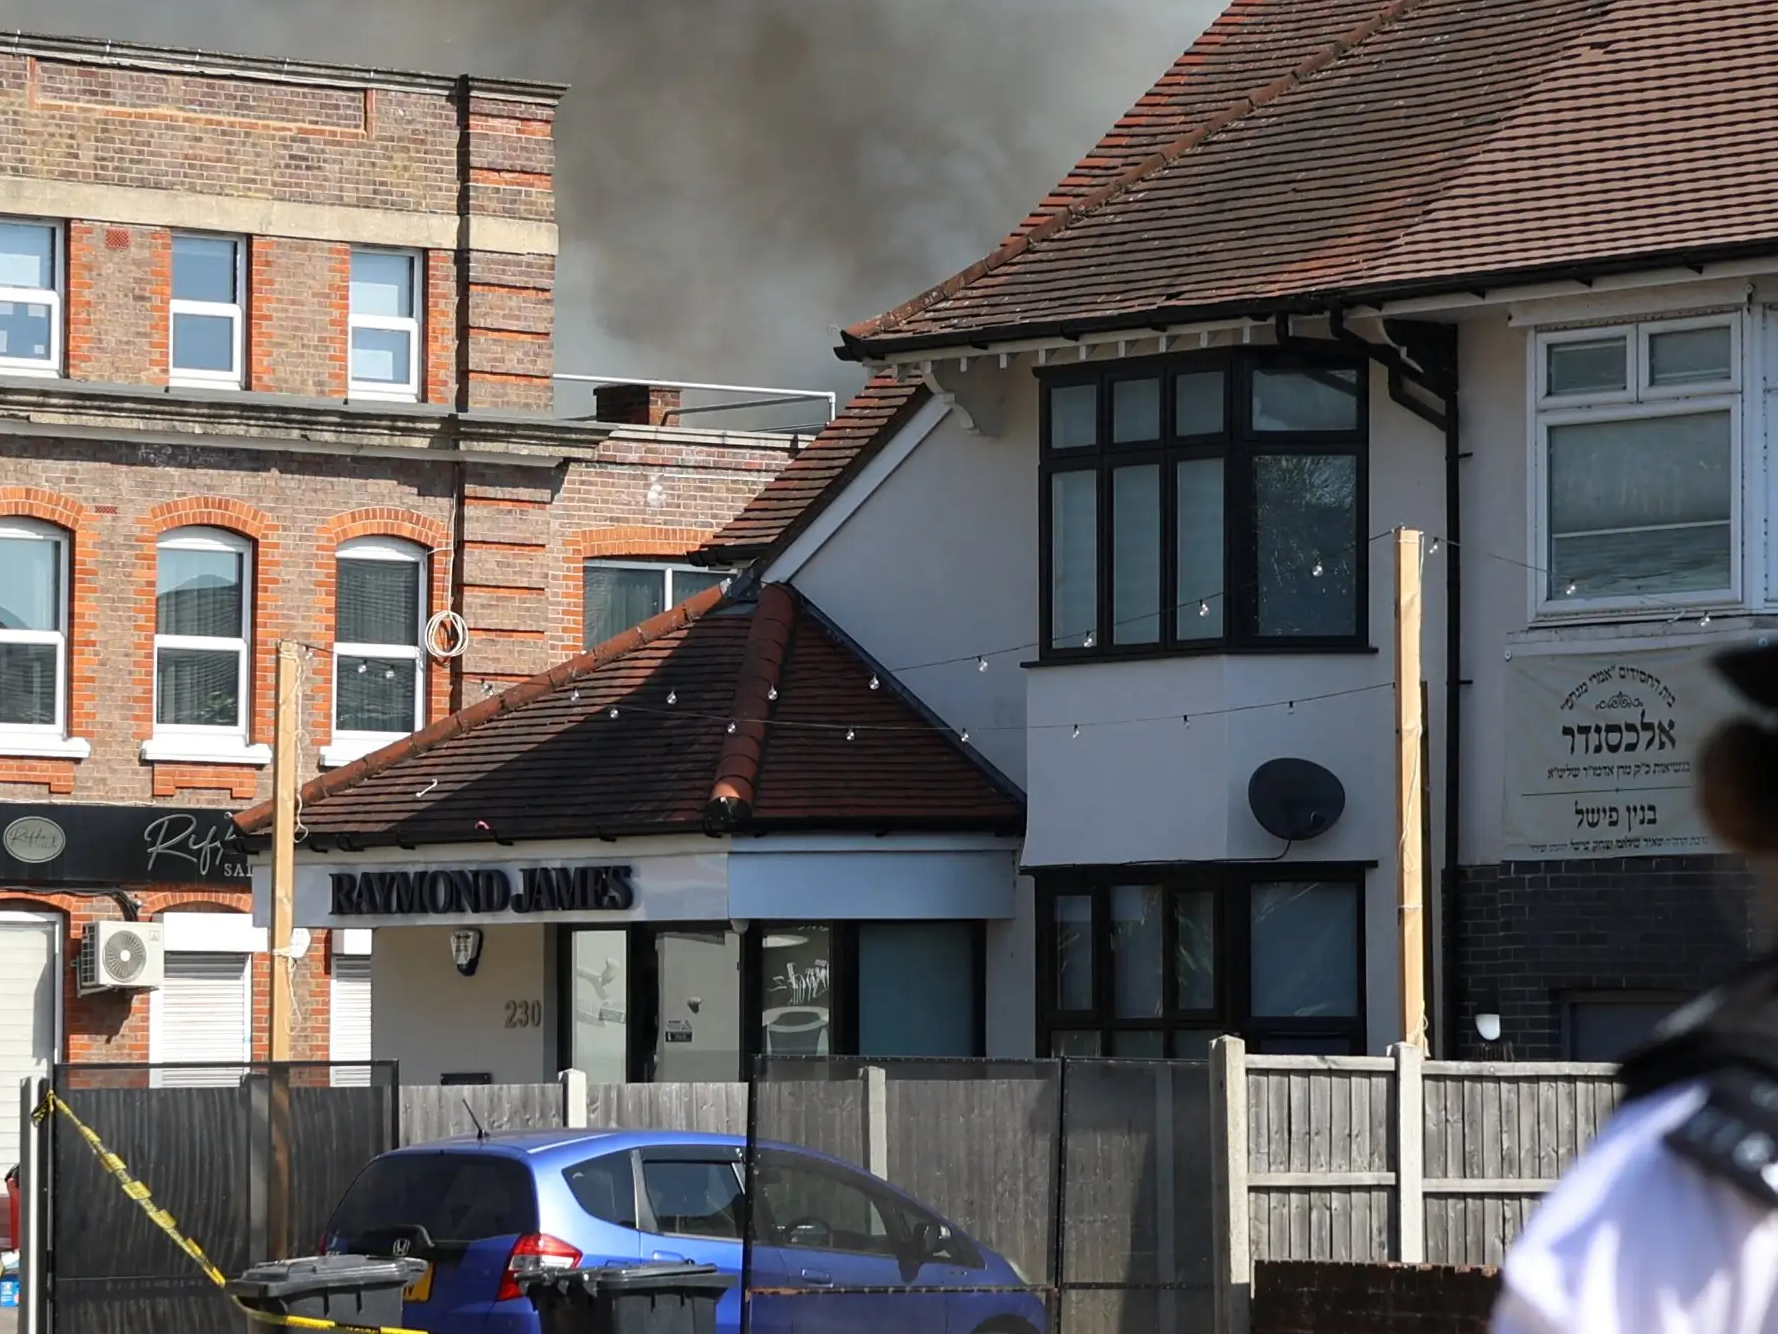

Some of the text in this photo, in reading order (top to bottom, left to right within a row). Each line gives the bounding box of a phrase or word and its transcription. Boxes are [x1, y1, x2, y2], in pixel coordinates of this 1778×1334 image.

[1561, 709, 1676, 755] אלכסנדר
[1574, 800, 1657, 832] בנין פישל
[328, 864, 634, 915] RAYMOND JAMES
[504, 999, 541, 1029] 230
